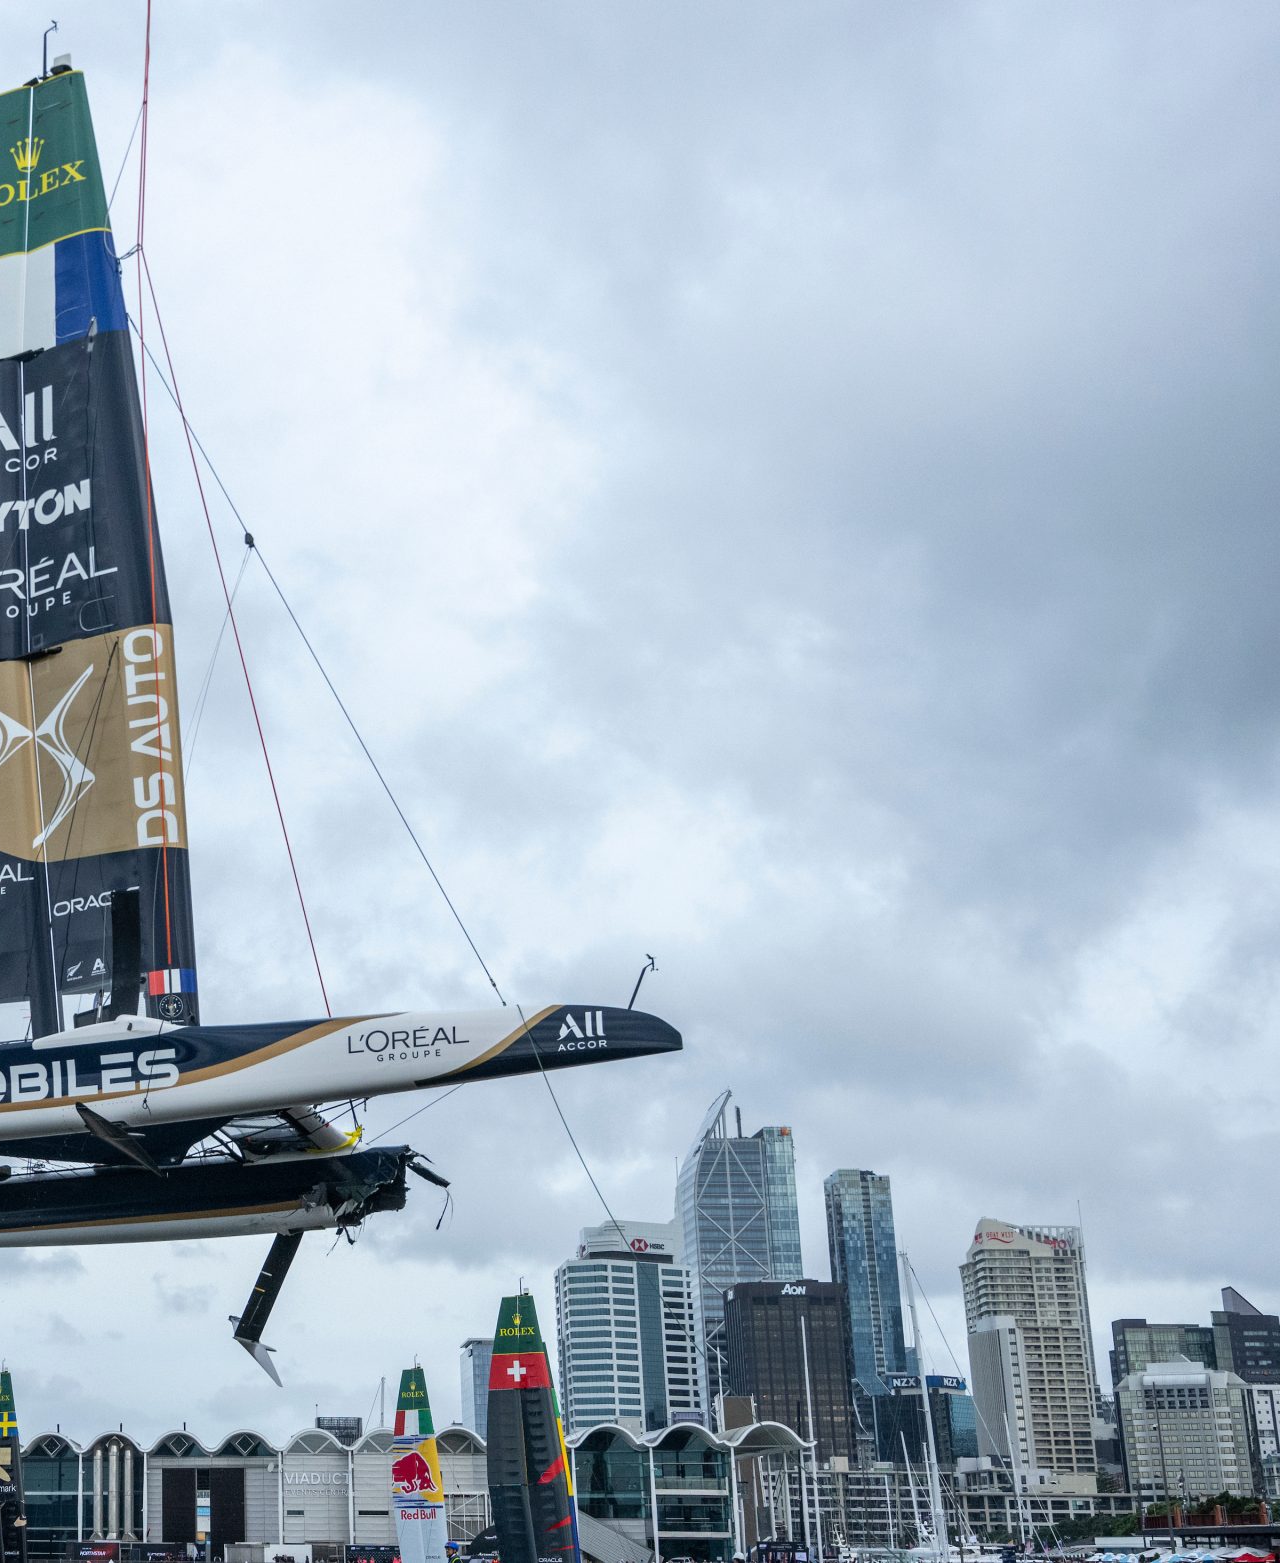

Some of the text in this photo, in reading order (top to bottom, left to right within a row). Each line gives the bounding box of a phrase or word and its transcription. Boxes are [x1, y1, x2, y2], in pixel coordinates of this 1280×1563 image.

[123, 629, 179, 847] DS AUTO
[53, 886, 140, 917] ORAC
[347, 1026, 470, 1054] L'ORÉAL
[557, 1039, 608, 1052] ACCOR
[376, 1049, 442, 1062] GROUPE
[499, 1327, 535, 1336] ROLEX
[892, 1377, 916, 1387] NZX
[943, 1377, 958, 1387] NZX
[400, 1509, 437, 1520] Red Bull
